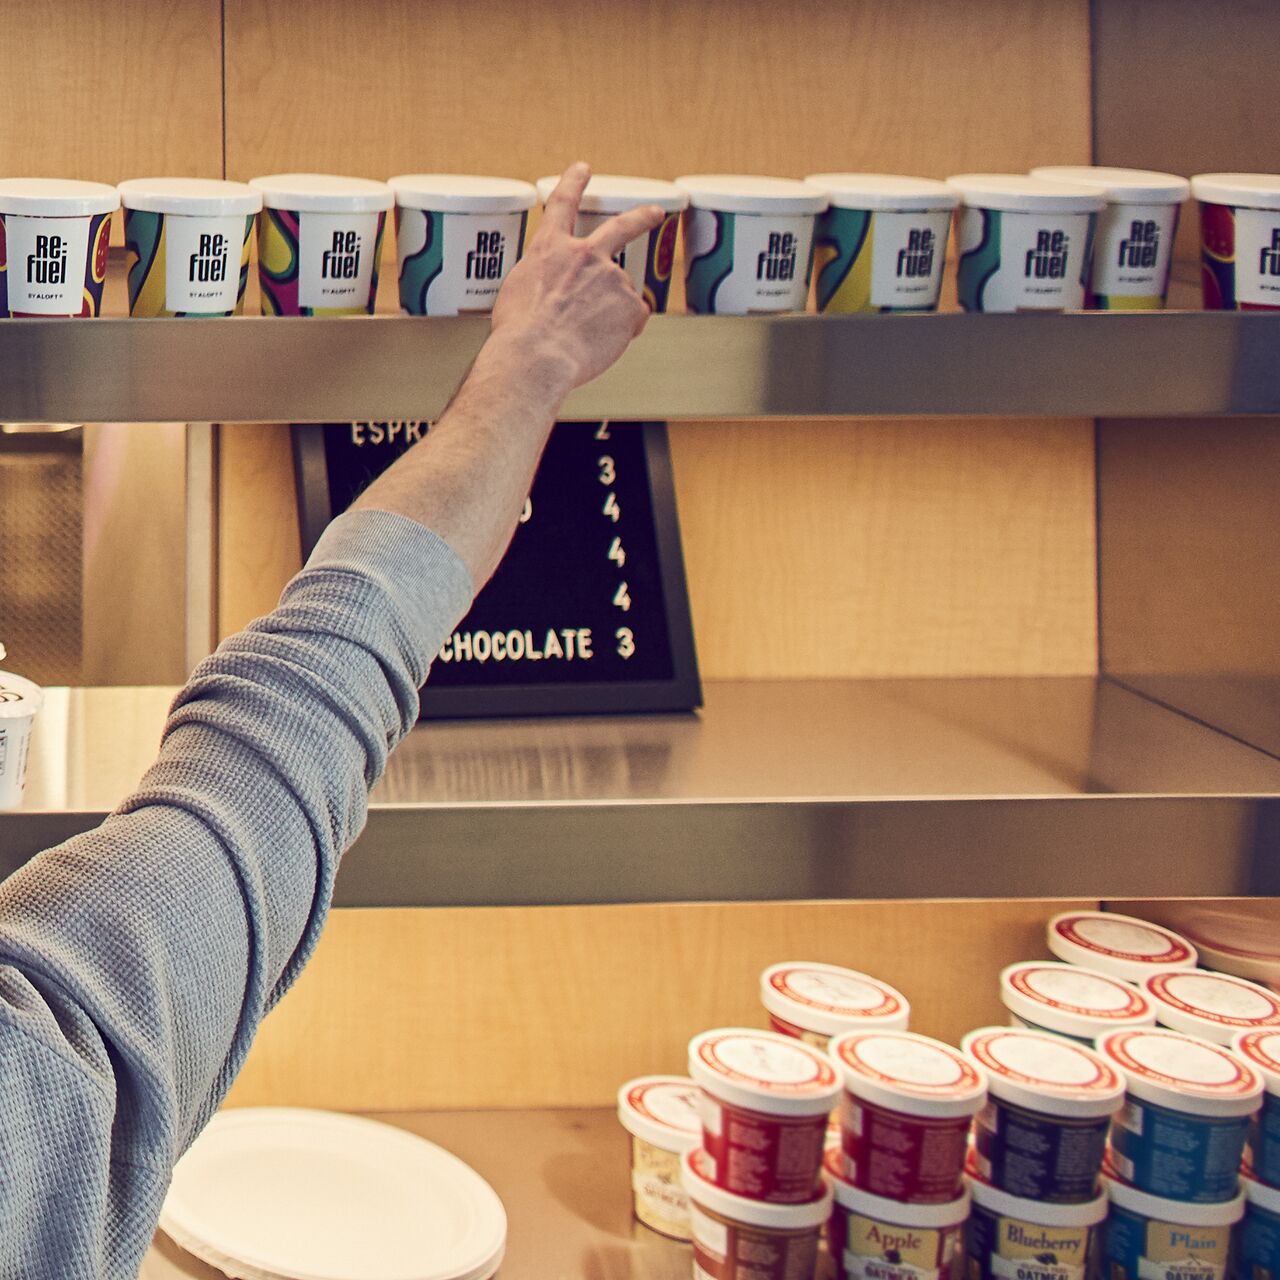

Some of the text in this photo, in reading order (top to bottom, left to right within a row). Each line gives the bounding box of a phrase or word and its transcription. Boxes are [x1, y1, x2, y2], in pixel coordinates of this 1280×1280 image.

[896, 247, 934, 279] fuel
[598, 456, 616, 486] 3
[602, 492, 621, 523] 4
[607, 536, 626, 568] 4
[613, 581, 632, 612] 4
[439, 627, 635, 663] CHOCOLATE 3
[865, 1225, 921, 1251] Apple
[1006, 1224, 1082, 1255] Blueberry
[1169, 1231, 1217, 1250] Plain
